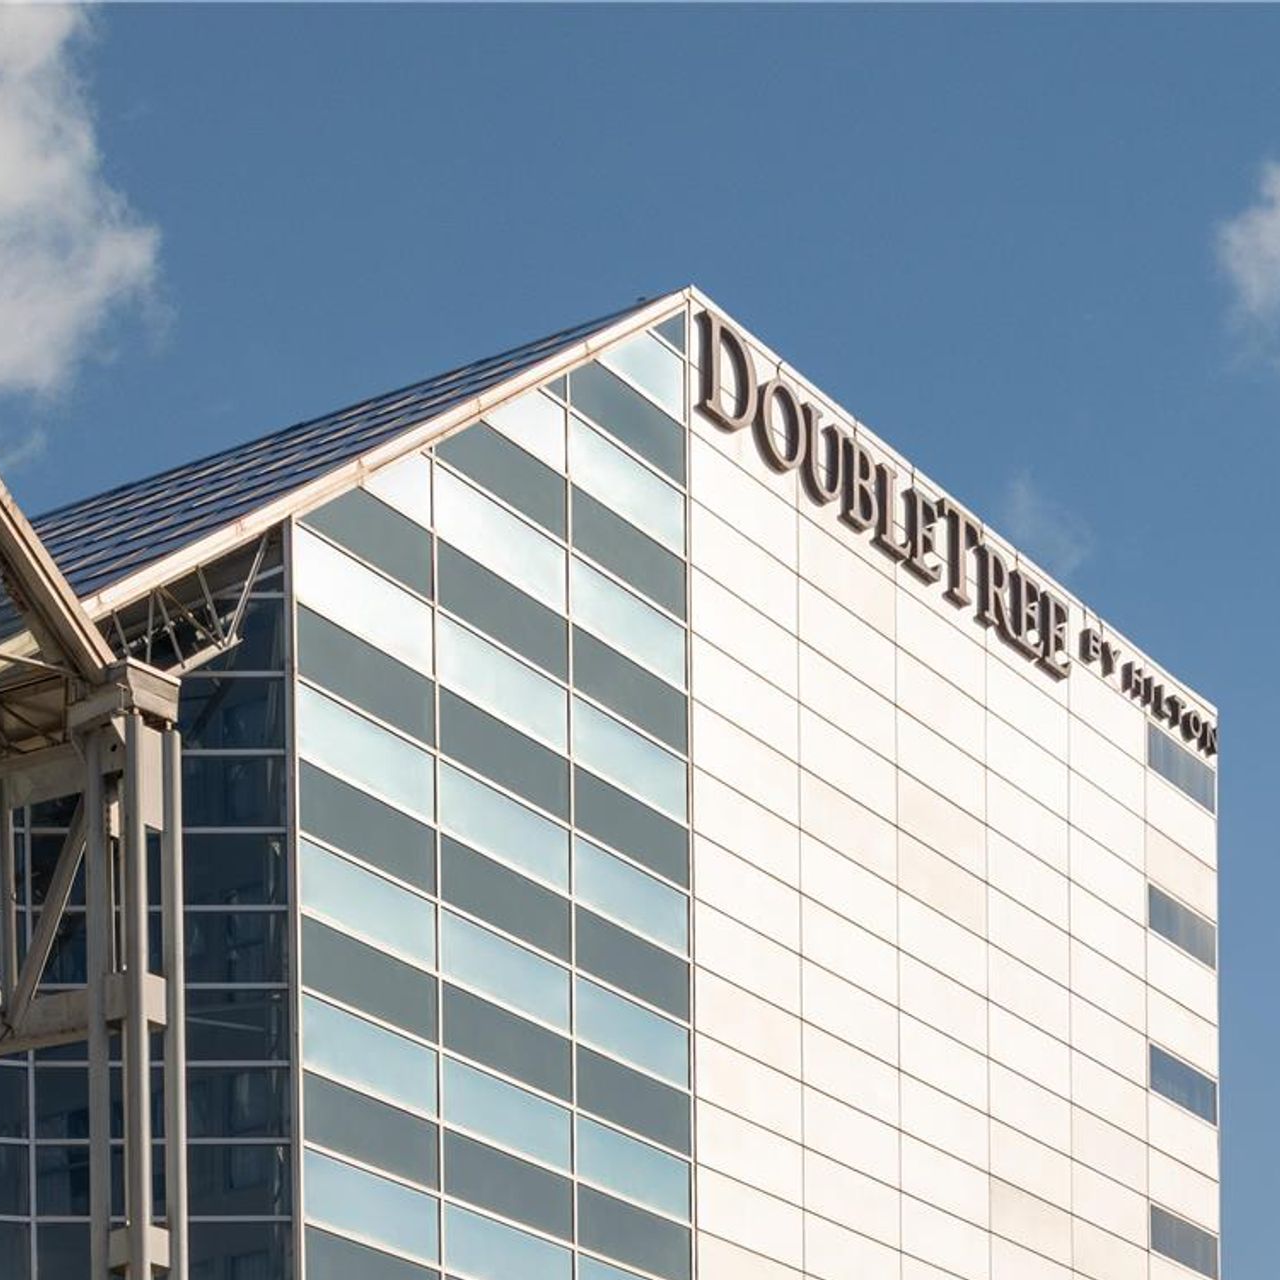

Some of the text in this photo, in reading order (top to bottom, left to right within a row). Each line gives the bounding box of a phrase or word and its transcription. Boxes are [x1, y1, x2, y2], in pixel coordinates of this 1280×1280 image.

[694, 309, 1217, 757] DOUBLETREE BY HILTON
